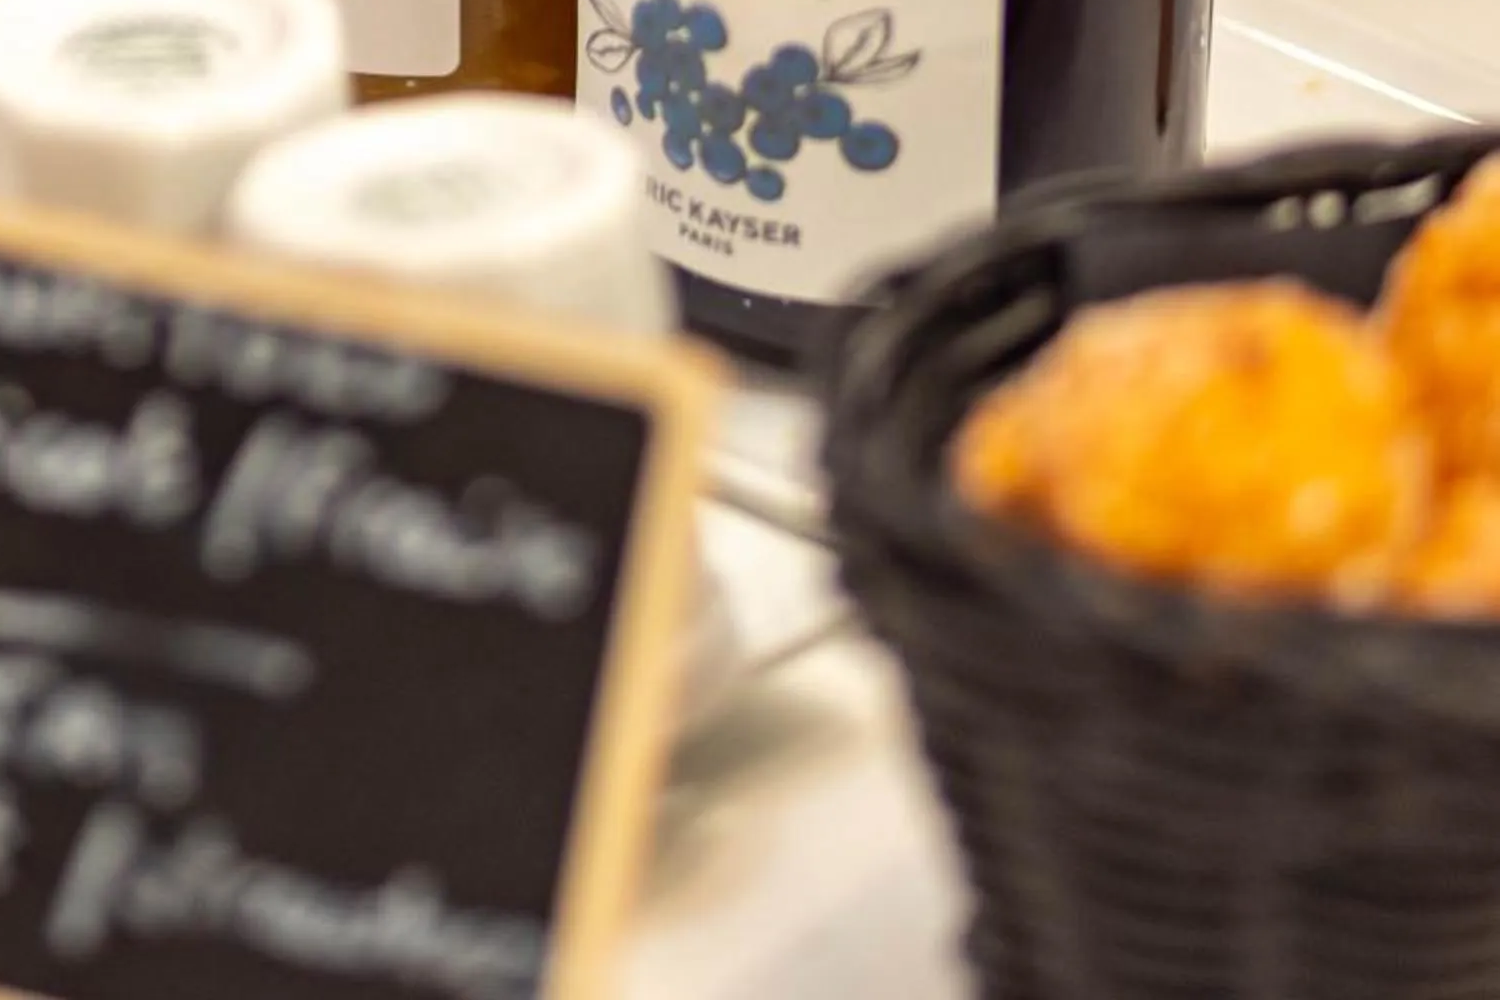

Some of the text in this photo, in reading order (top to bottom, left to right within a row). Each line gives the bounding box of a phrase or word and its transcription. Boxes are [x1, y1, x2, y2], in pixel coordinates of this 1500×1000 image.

[644, 174, 803, 247] RIC KAYSER
[677, 221, 735, 258] PARIS
